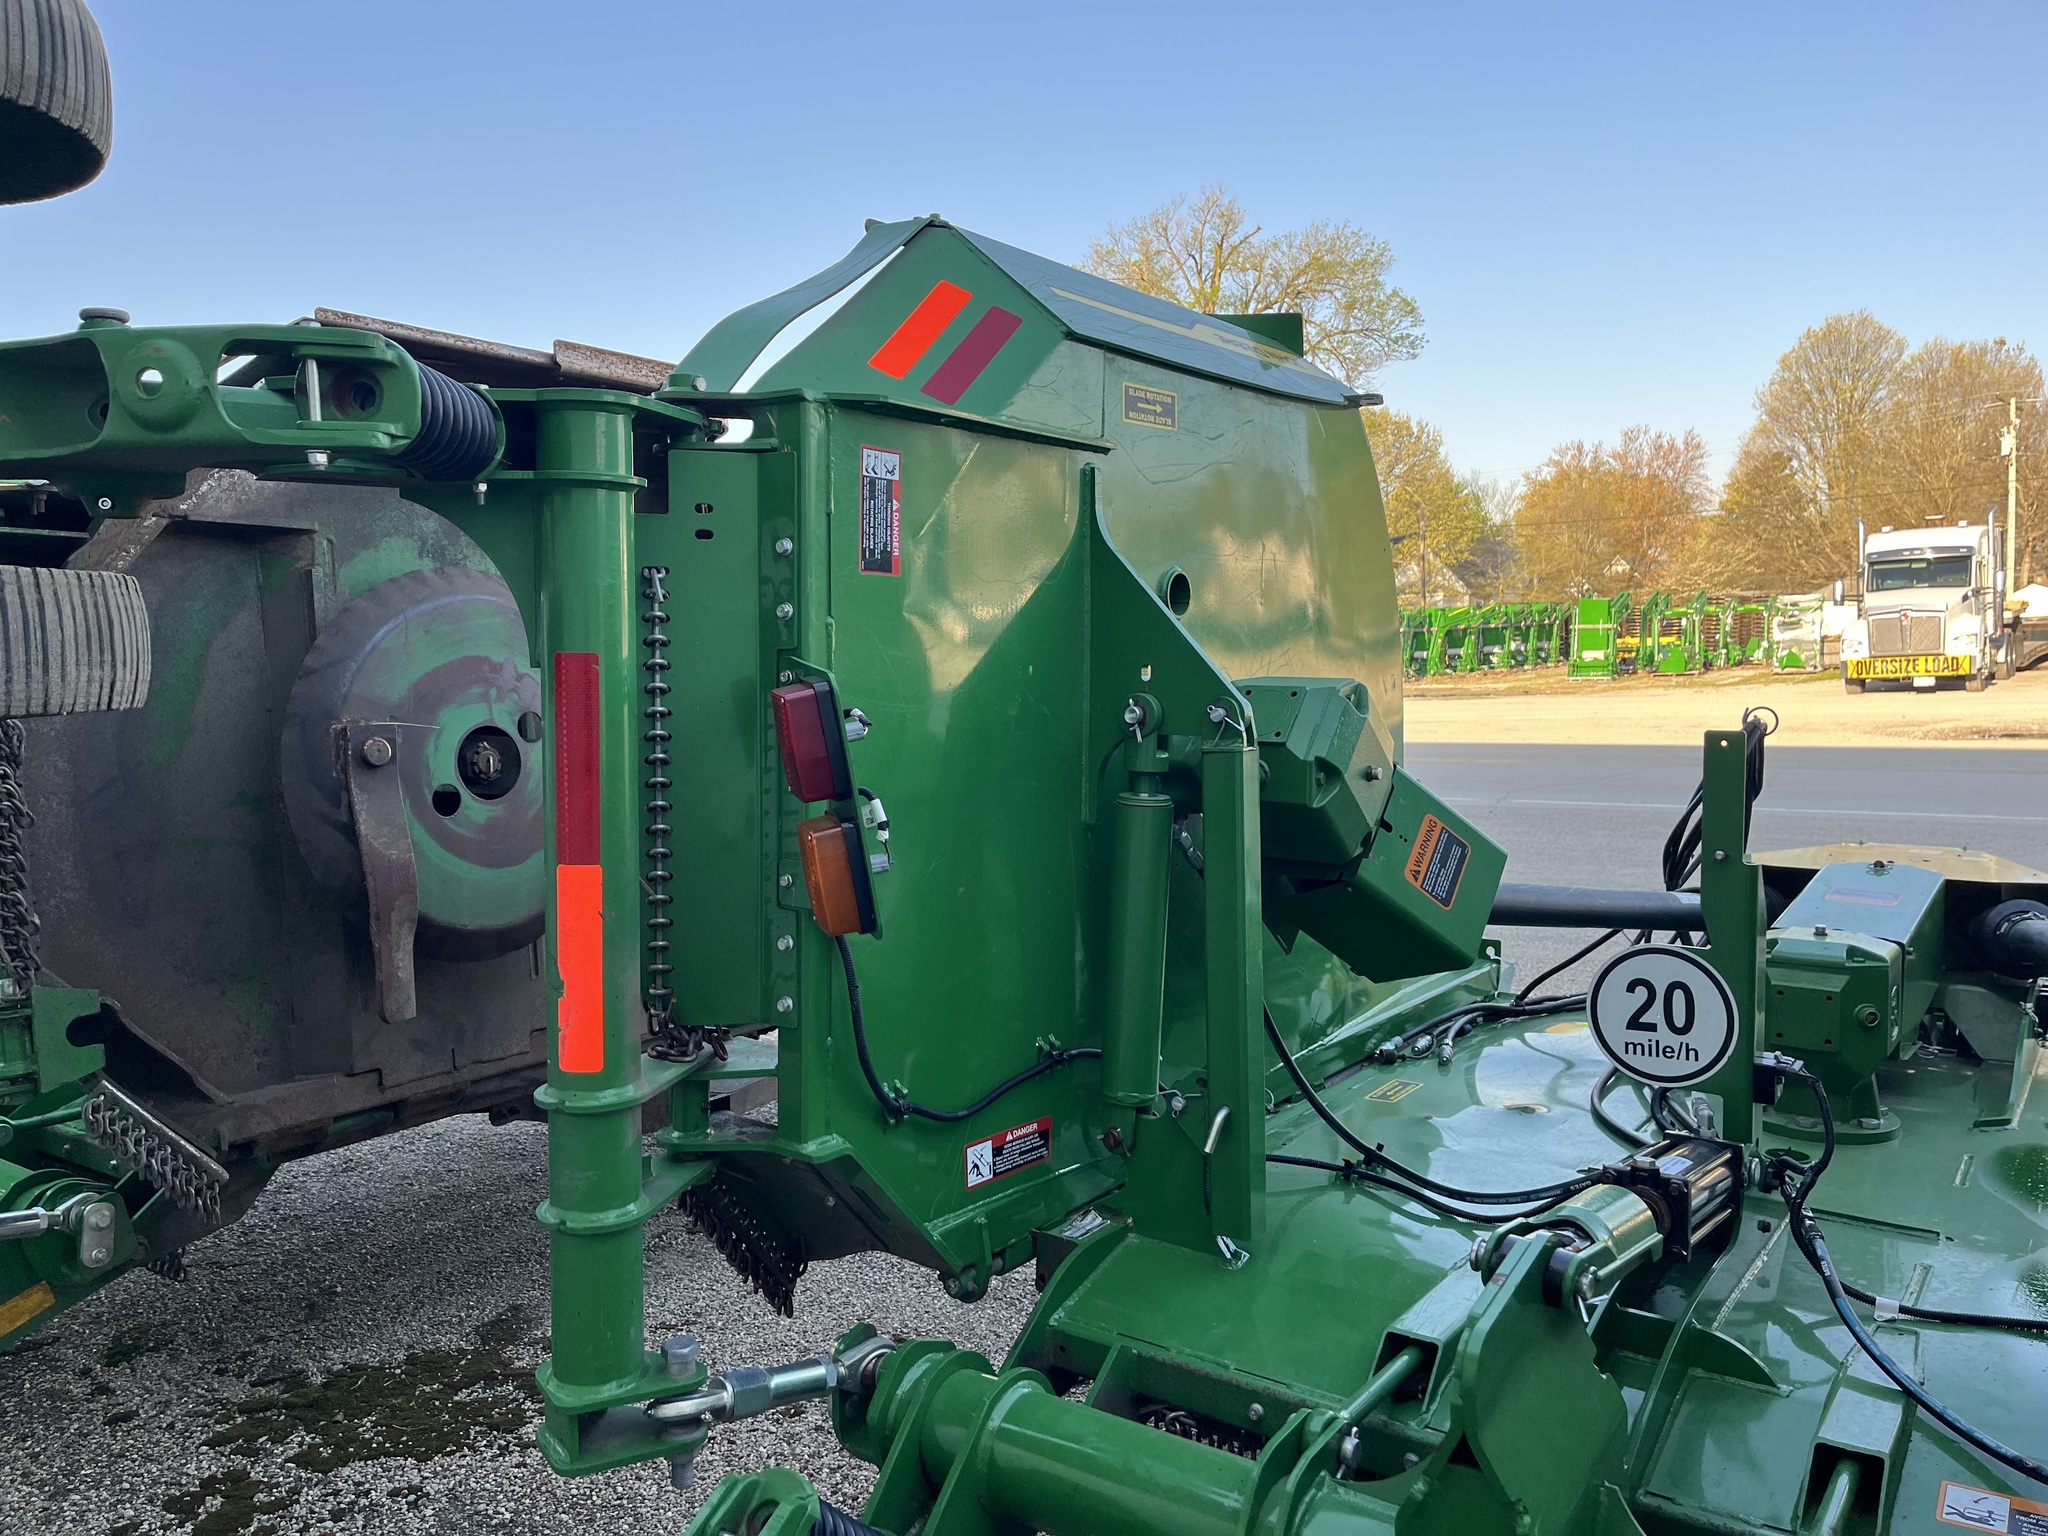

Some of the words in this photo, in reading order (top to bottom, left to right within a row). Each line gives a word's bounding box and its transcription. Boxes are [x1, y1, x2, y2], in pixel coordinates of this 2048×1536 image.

[1128, 387, 1146, 399] BLADE
[1146, 391, 1172, 404] ROTATION
[1128, 410, 1155, 423] ROTATION
[1155, 415, 1172, 426] BLADE
[1856, 658, 1920, 676] OVERSIZE
[1925, 656, 1960, 674] LOAD
[1413, 819, 1438, 868] WARNING
[1625, 977, 1696, 1036] 20
[1624, 1038, 1699, 1062] mile/h
[1012, 1122, 1038, 1138] DANGER
[2015, 1514, 2036, 1523] FROM
